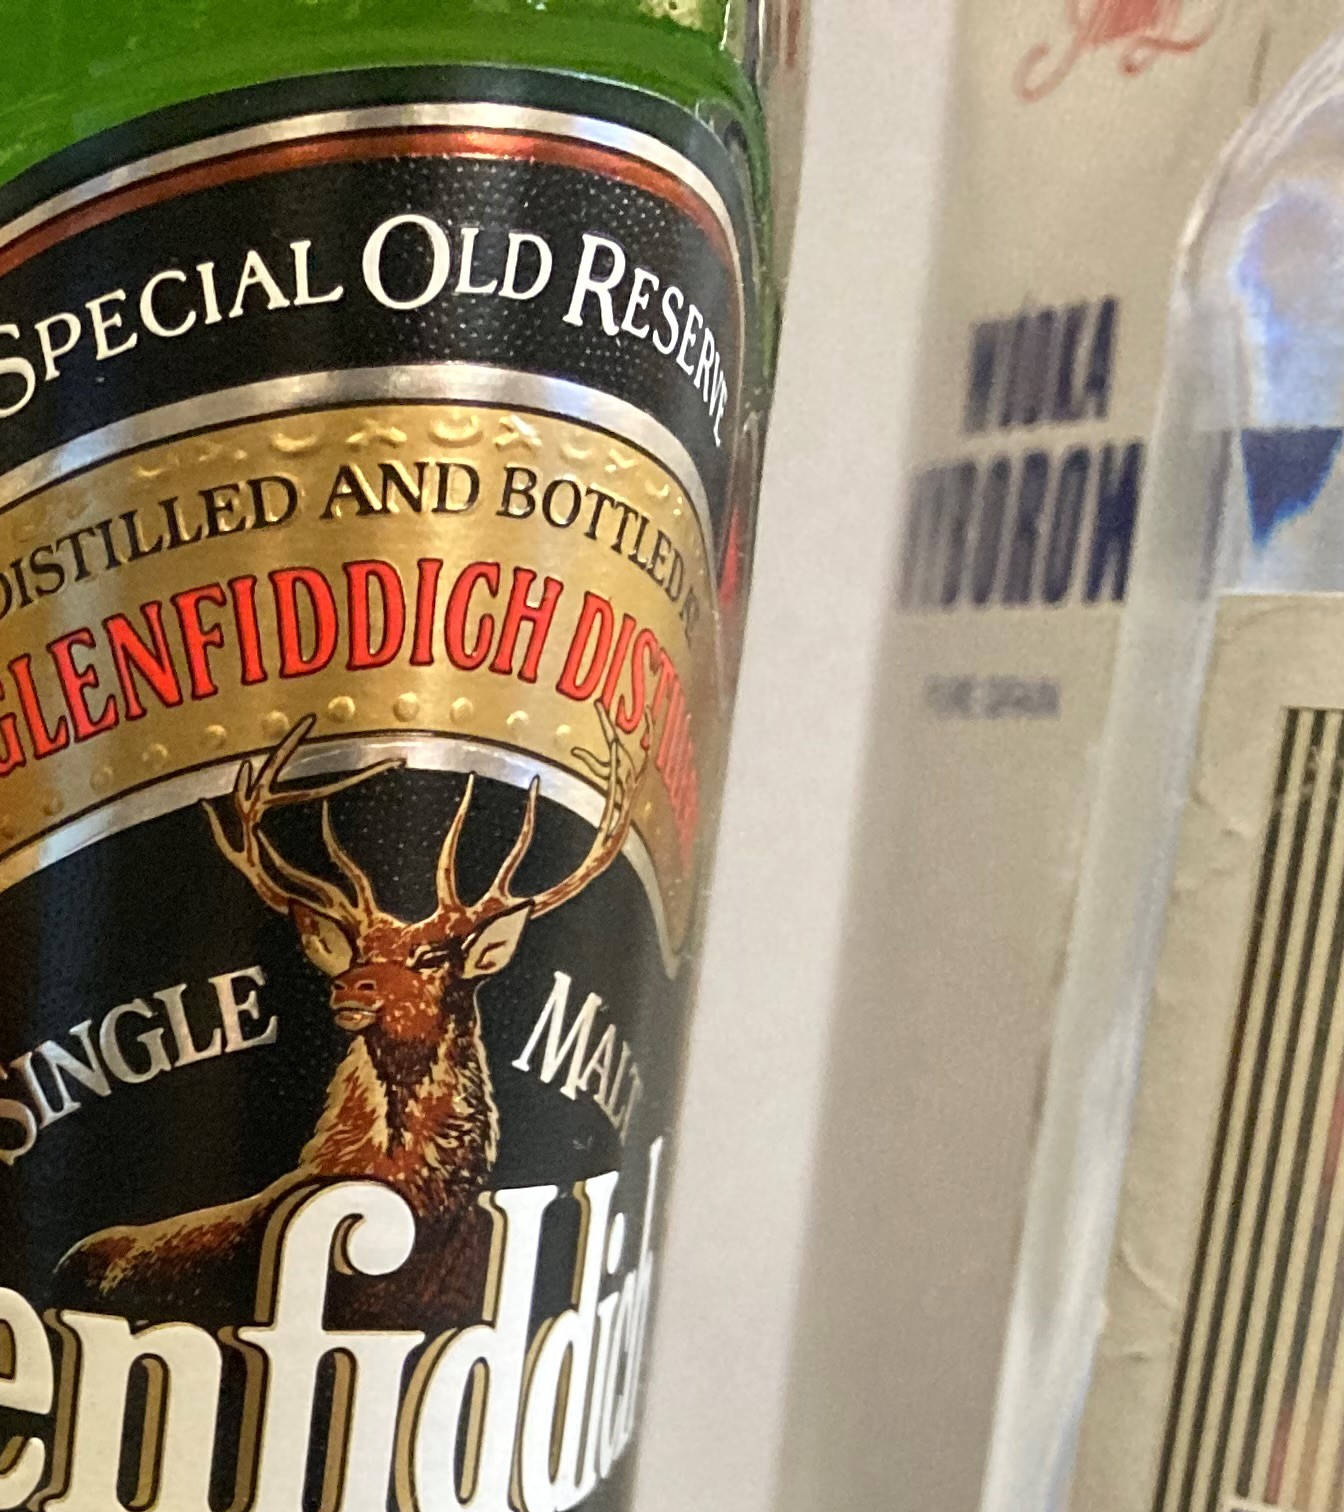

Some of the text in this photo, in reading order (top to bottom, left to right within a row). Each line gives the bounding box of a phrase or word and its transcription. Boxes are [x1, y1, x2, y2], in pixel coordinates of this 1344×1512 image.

[360, 213, 555, 311] OLD
[561, 232, 729, 448] RESERVE
[318, 461, 484, 521] AND
[495, 463, 686, 604] BOTTLED
[511, 970, 648, 1145] MALT
